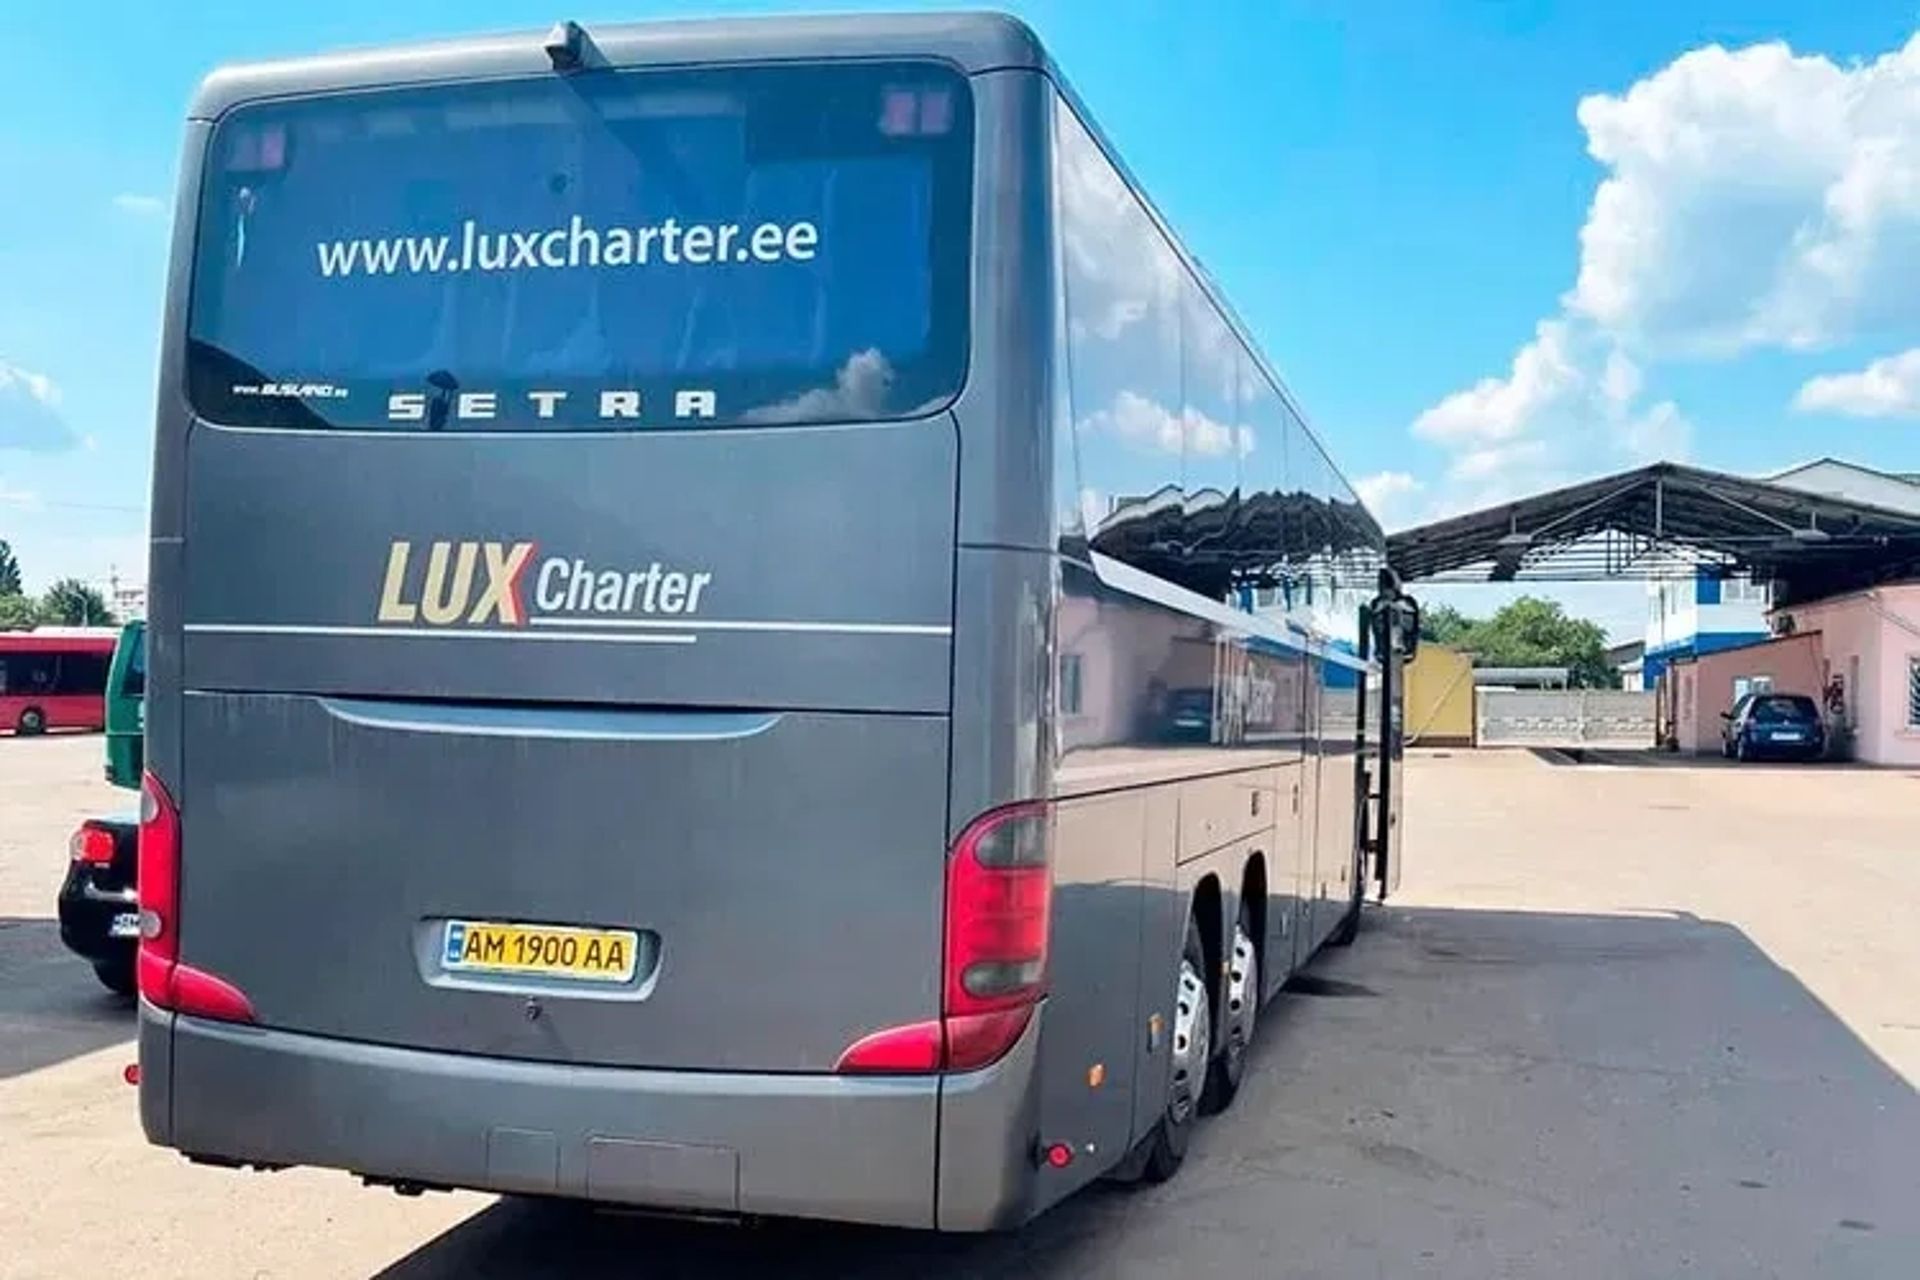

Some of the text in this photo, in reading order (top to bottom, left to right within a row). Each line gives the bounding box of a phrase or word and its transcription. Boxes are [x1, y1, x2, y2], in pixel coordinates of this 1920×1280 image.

[317, 216, 818, 277] www.luxcharter.ee
[388, 391, 717, 419] SETRA
[378, 541, 711, 625] LUX Charter
[464, 931, 624, 970] AM 1900 AA
